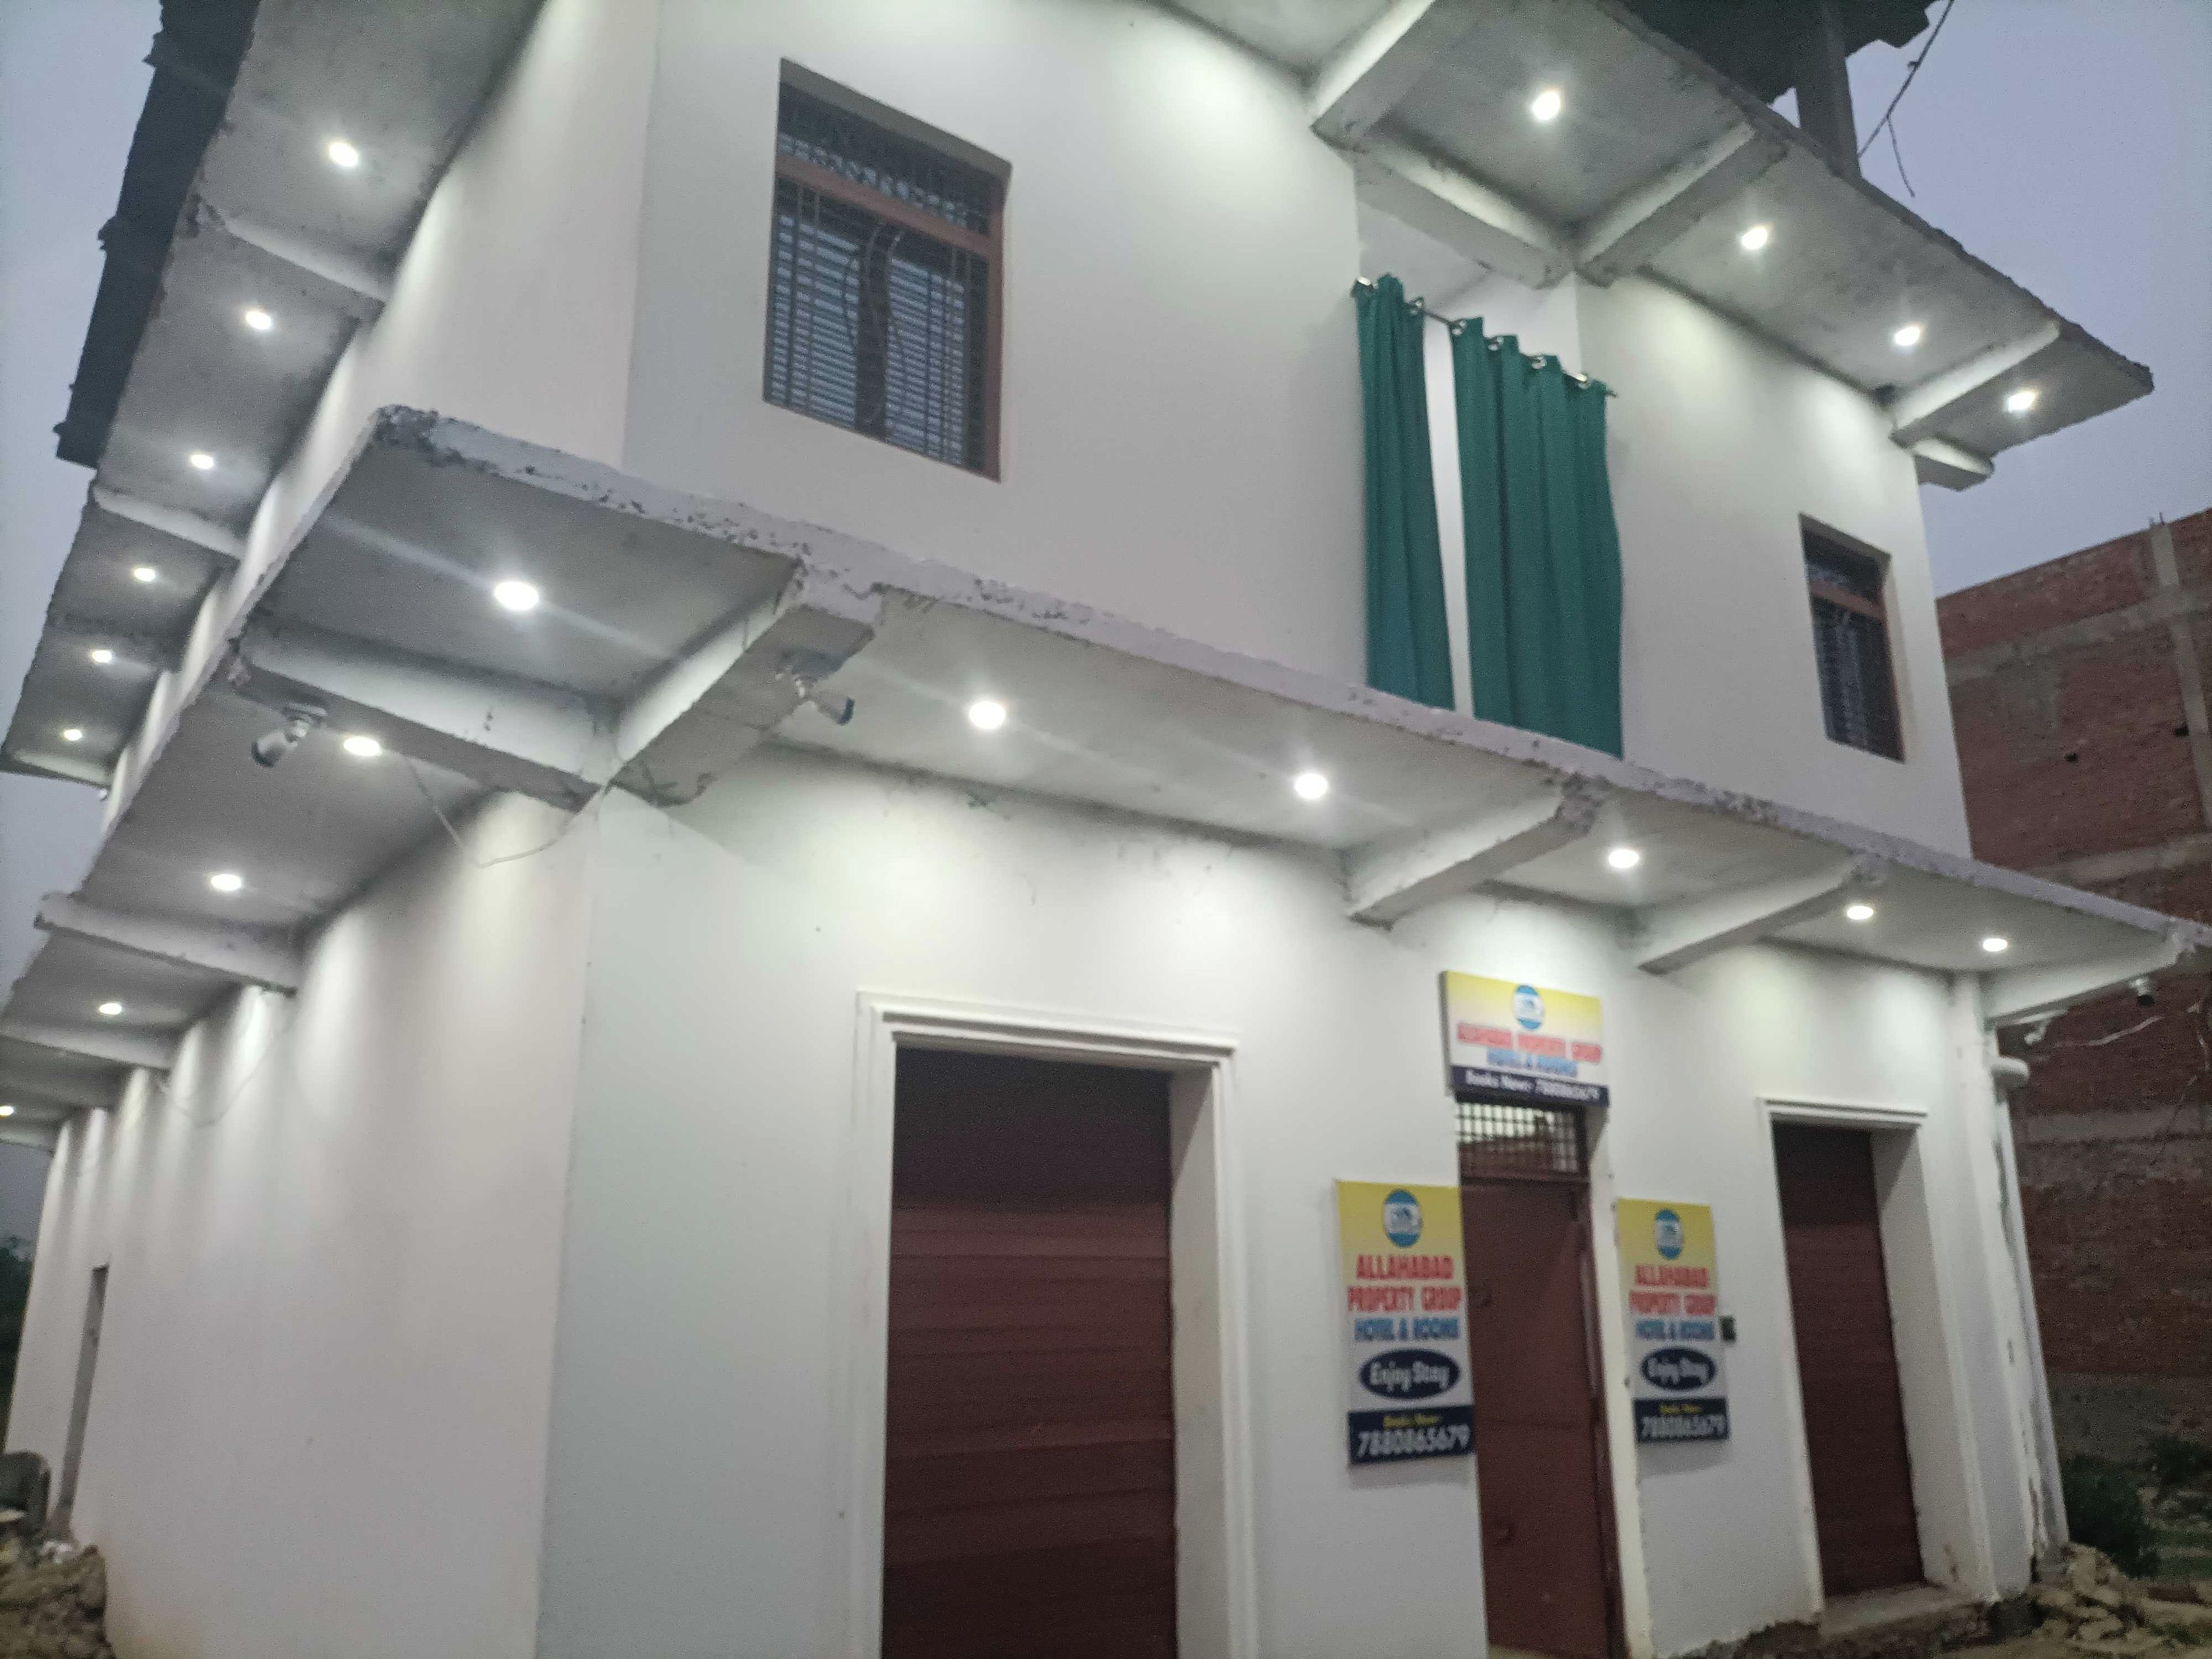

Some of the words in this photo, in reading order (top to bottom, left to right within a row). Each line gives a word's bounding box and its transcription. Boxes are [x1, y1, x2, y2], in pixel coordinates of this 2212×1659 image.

[1357, 1253, 1454, 1280] ALLAHABAD
[1635, 1264, 1709, 1289] ALLAHABAD
[1347, 1286, 1415, 1311] PROPERTY
[1421, 1286, 1461, 1311] GROUP
[1629, 1291, 1680, 1315] PROPERTY
[1684, 1294, 1717, 1316] GROUP
[1354, 1317, 1395, 1340] HOTEL
[1399, 1317, 1408, 1340] &
[1414, 1317, 1459, 1340] ROOMS
[1369, 1361, 1411, 1392] Enjoy
[1412, 1361, 1450, 1391] Stay
[1647, 1357, 1680, 1385] Enjoy
[1679, 1357, 1710, 1384] Stay
